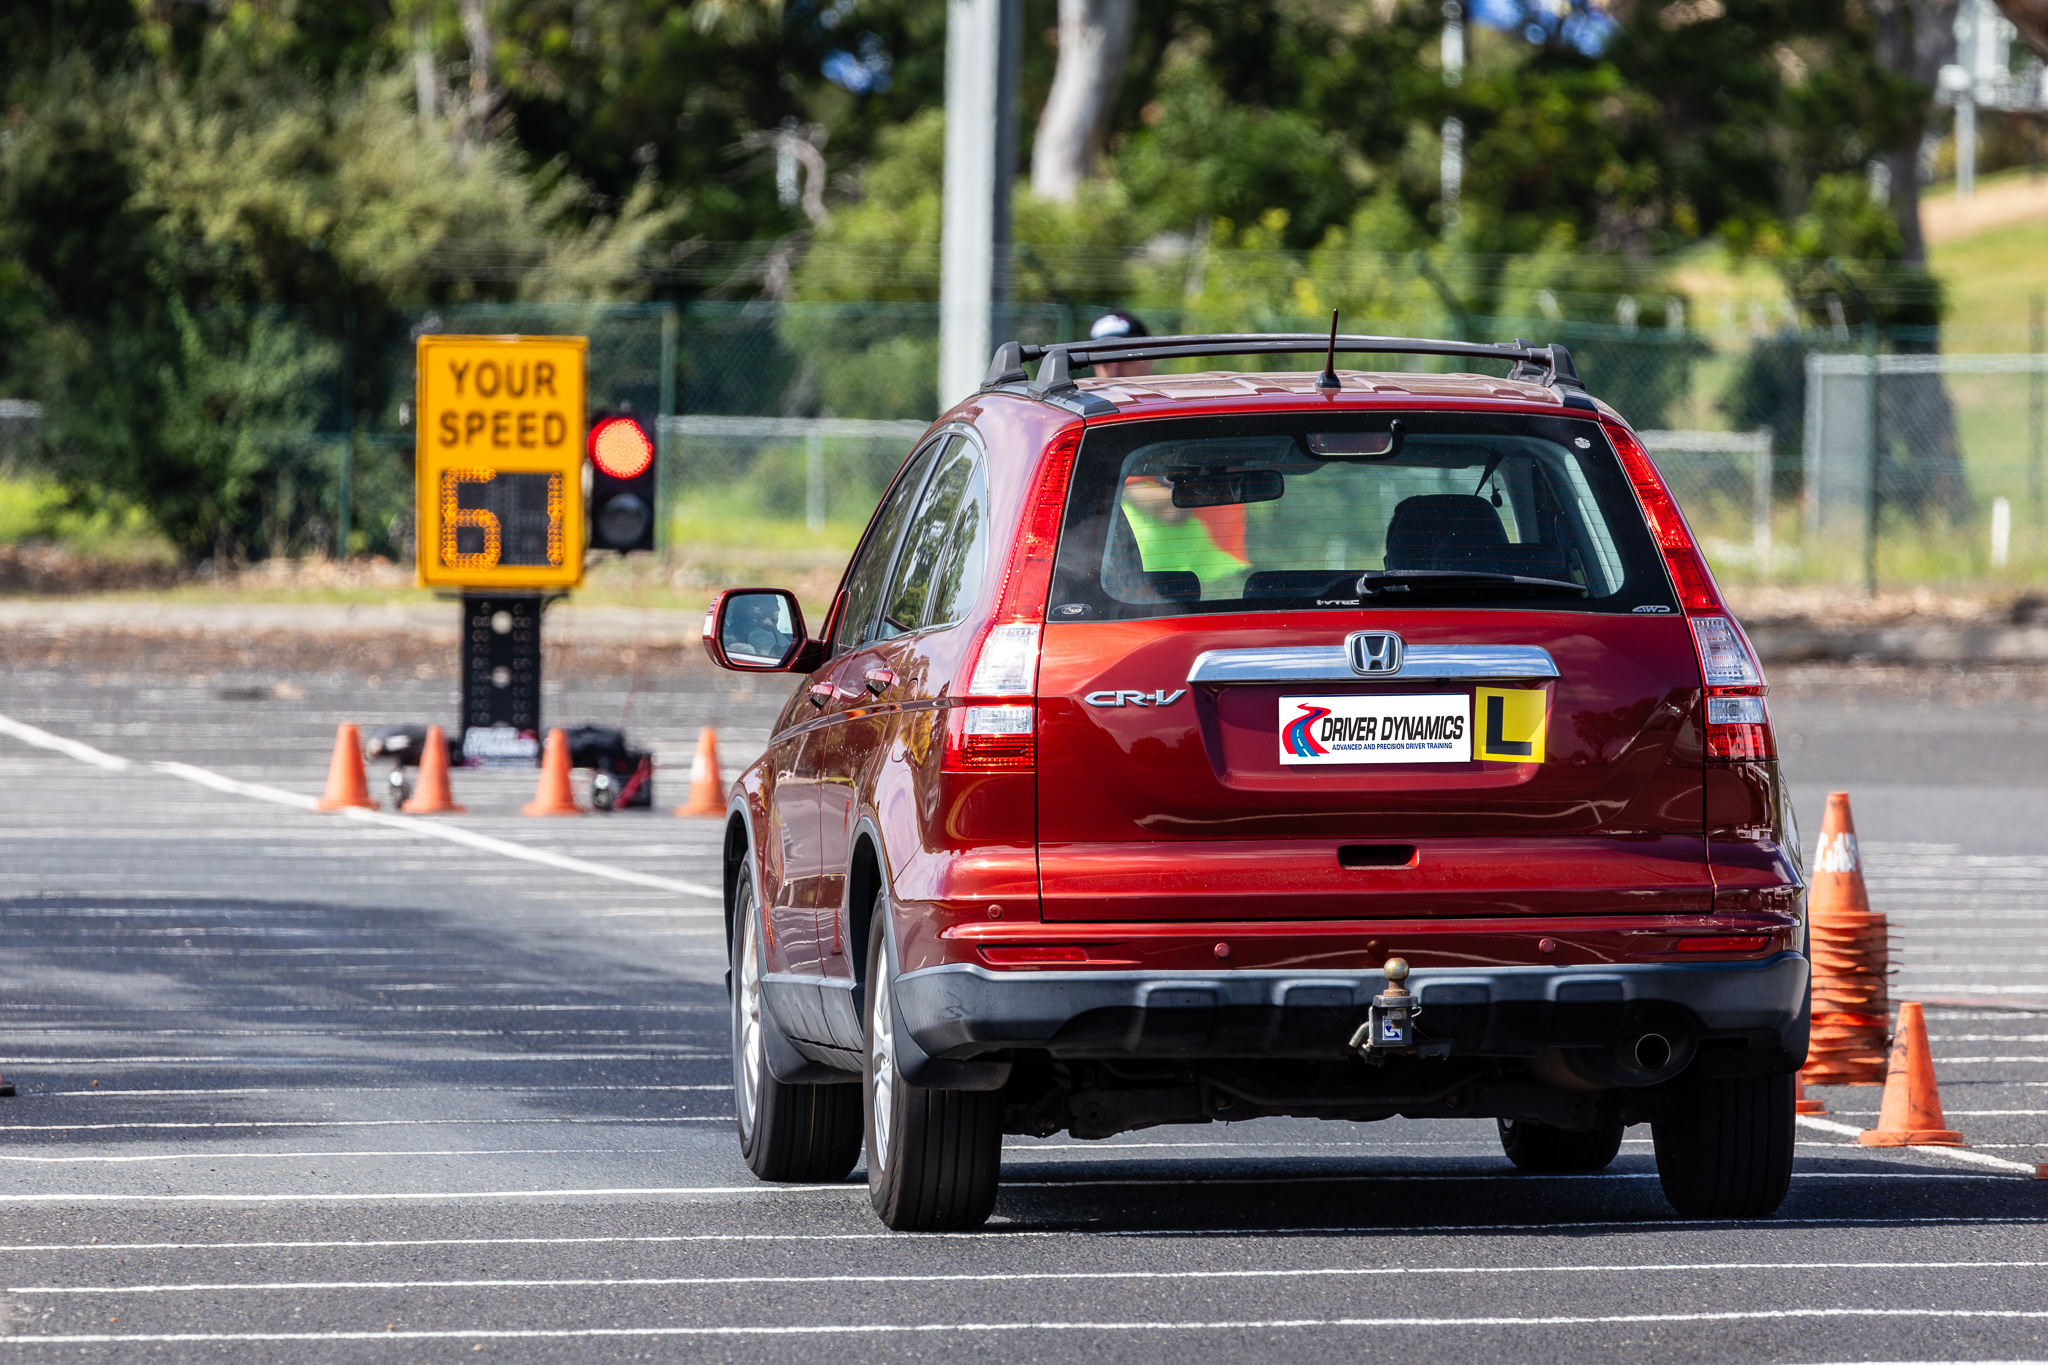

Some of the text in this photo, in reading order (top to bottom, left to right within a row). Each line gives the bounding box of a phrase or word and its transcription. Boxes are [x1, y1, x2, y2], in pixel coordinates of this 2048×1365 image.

[448, 359, 558, 399] YOUR
[438, 409, 567, 449] SPEED
[441, 466, 564, 571] 61
[1084, 690, 1187, 707] CR-V
[1320, 715, 1464, 742] DRIVER DYNAMICS
[1486, 695, 1532, 756] L
[1331, 743, 1363, 751] ADVANCED
